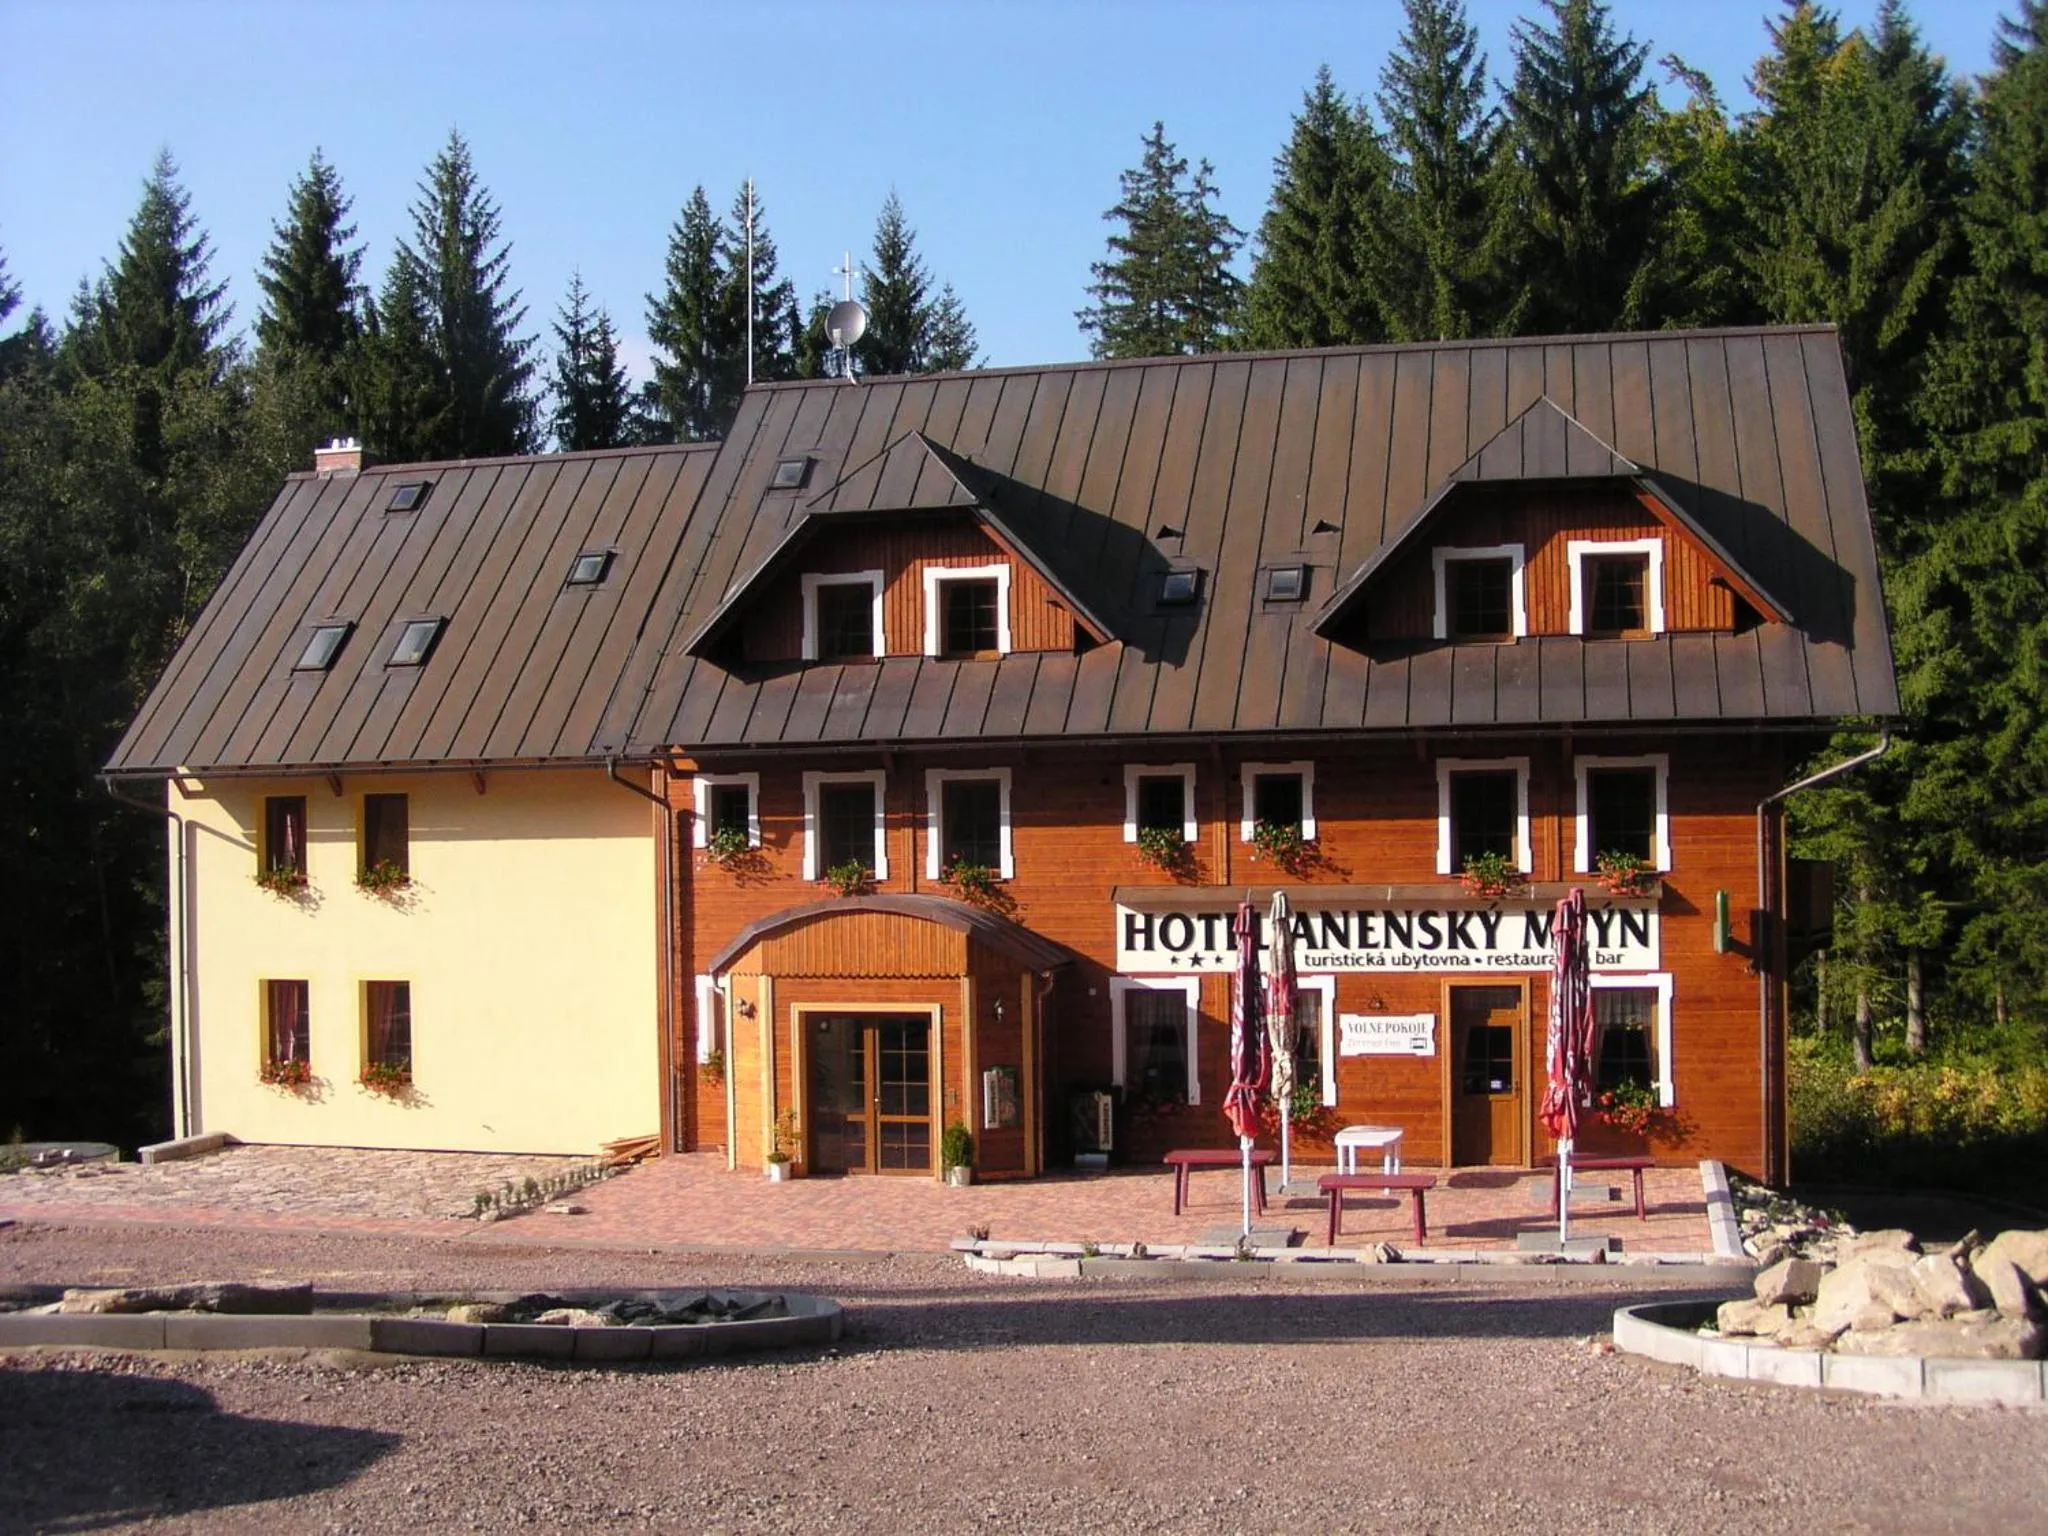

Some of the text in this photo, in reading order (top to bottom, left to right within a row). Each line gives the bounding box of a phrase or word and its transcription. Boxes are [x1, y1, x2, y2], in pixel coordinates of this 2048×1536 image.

[1290, 902, 1503, 951] ANENSKÝ
[1522, 901, 1649, 949] MÝN
[1304, 952, 1386, 967] turistická
[1391, 952, 1471, 969] ubytovna
[1595, 951, 1625, 965] bar
